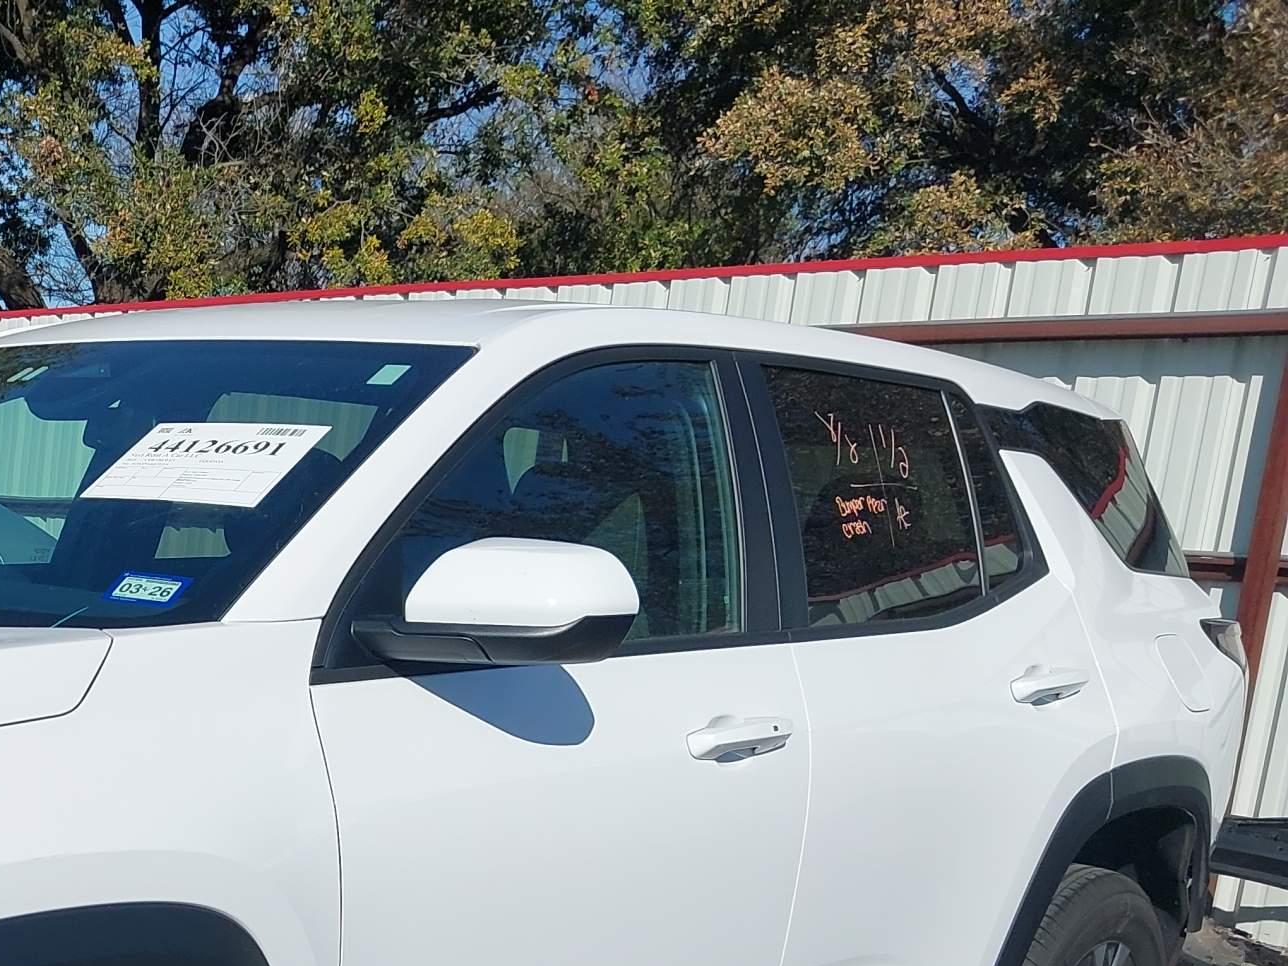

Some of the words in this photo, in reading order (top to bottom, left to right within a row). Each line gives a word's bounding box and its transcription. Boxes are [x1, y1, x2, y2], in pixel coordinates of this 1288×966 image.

[148, 438, 287, 457] 44126691
[119, 582, 143, 594] 03
[148, 586, 173, 598] 26
